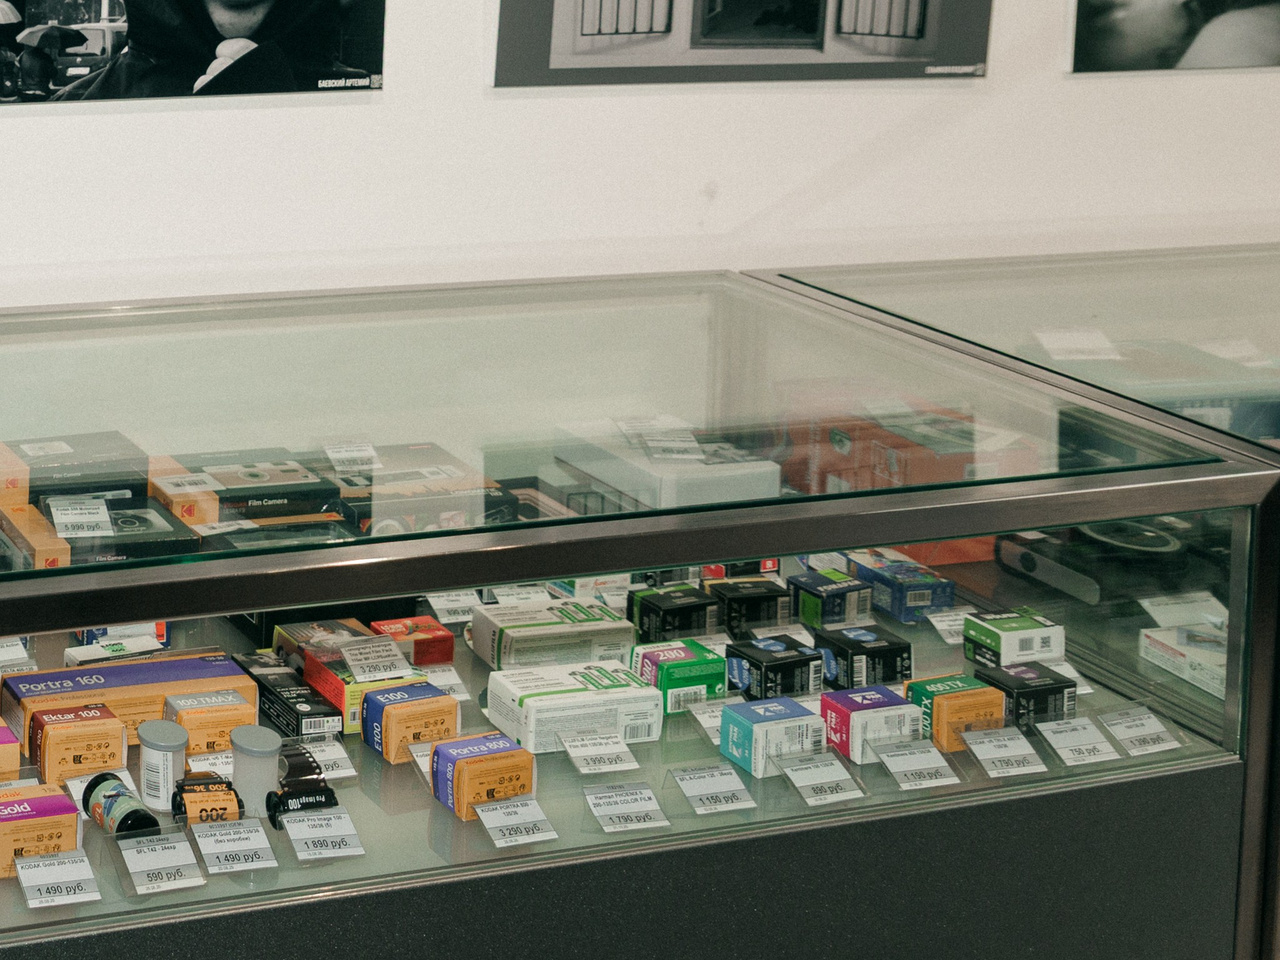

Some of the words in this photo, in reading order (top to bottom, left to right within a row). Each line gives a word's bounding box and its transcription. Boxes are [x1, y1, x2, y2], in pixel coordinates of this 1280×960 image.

[263, 498, 288, 506] Camera
[655, 649, 686, 660] 200
[367, 664, 381, 673] 290
[383, 662, 399, 672] руб.
[19, 680, 74, 693] Portra
[76, 675, 105, 685] 160
[176, 696, 198, 707] 100
[199, 694, 236, 705] TMAX
[376, 692, 409, 703] E100
[42, 712, 76, 722] Ektar
[78, 709, 100, 718] 100
[374, 722, 382, 752] E100
[449, 743, 486, 756] Portra
[486, 740, 510, 750] 800
[1070, 748, 1084, 756] 750
[1085, 746, 1101, 757] руб.
[589, 756, 606, 764] 990
[608, 755, 626, 764] руб.
[998, 758, 1013, 767] 790
[1015, 756, 1032, 767] руб.
[325, 762, 343, 771] руб.
[446, 763, 454, 780] 800
[911, 771, 926, 780] 190
[928, 770, 945, 780] руб.
[446, 781, 454, 808] Portra
[829, 783, 846, 795] руб.
[301, 796, 316, 804] Image
[706, 796, 722, 804] 150
[722, 793, 741, 804] руб.
[288, 799, 301, 810] 100
[199, 807, 228, 822] 200
[318, 816, 333, 824] Image
[616, 814, 633, 823] 790
[635, 813, 655, 823] руб.
[499, 828, 506, 837] 3
[507, 826, 522, 836] 290
[524, 824, 543, 836] руб.
[312, 839, 329, 848] 890
[331, 838, 350, 849] руб.
[224, 853, 241, 863] 490
[243, 851, 264, 863] руб.
[146, 872, 164, 882] 590
[166, 868, 186, 881] руб.
[45, 885, 63, 895] 490
[65, 882, 87, 895] руб.
